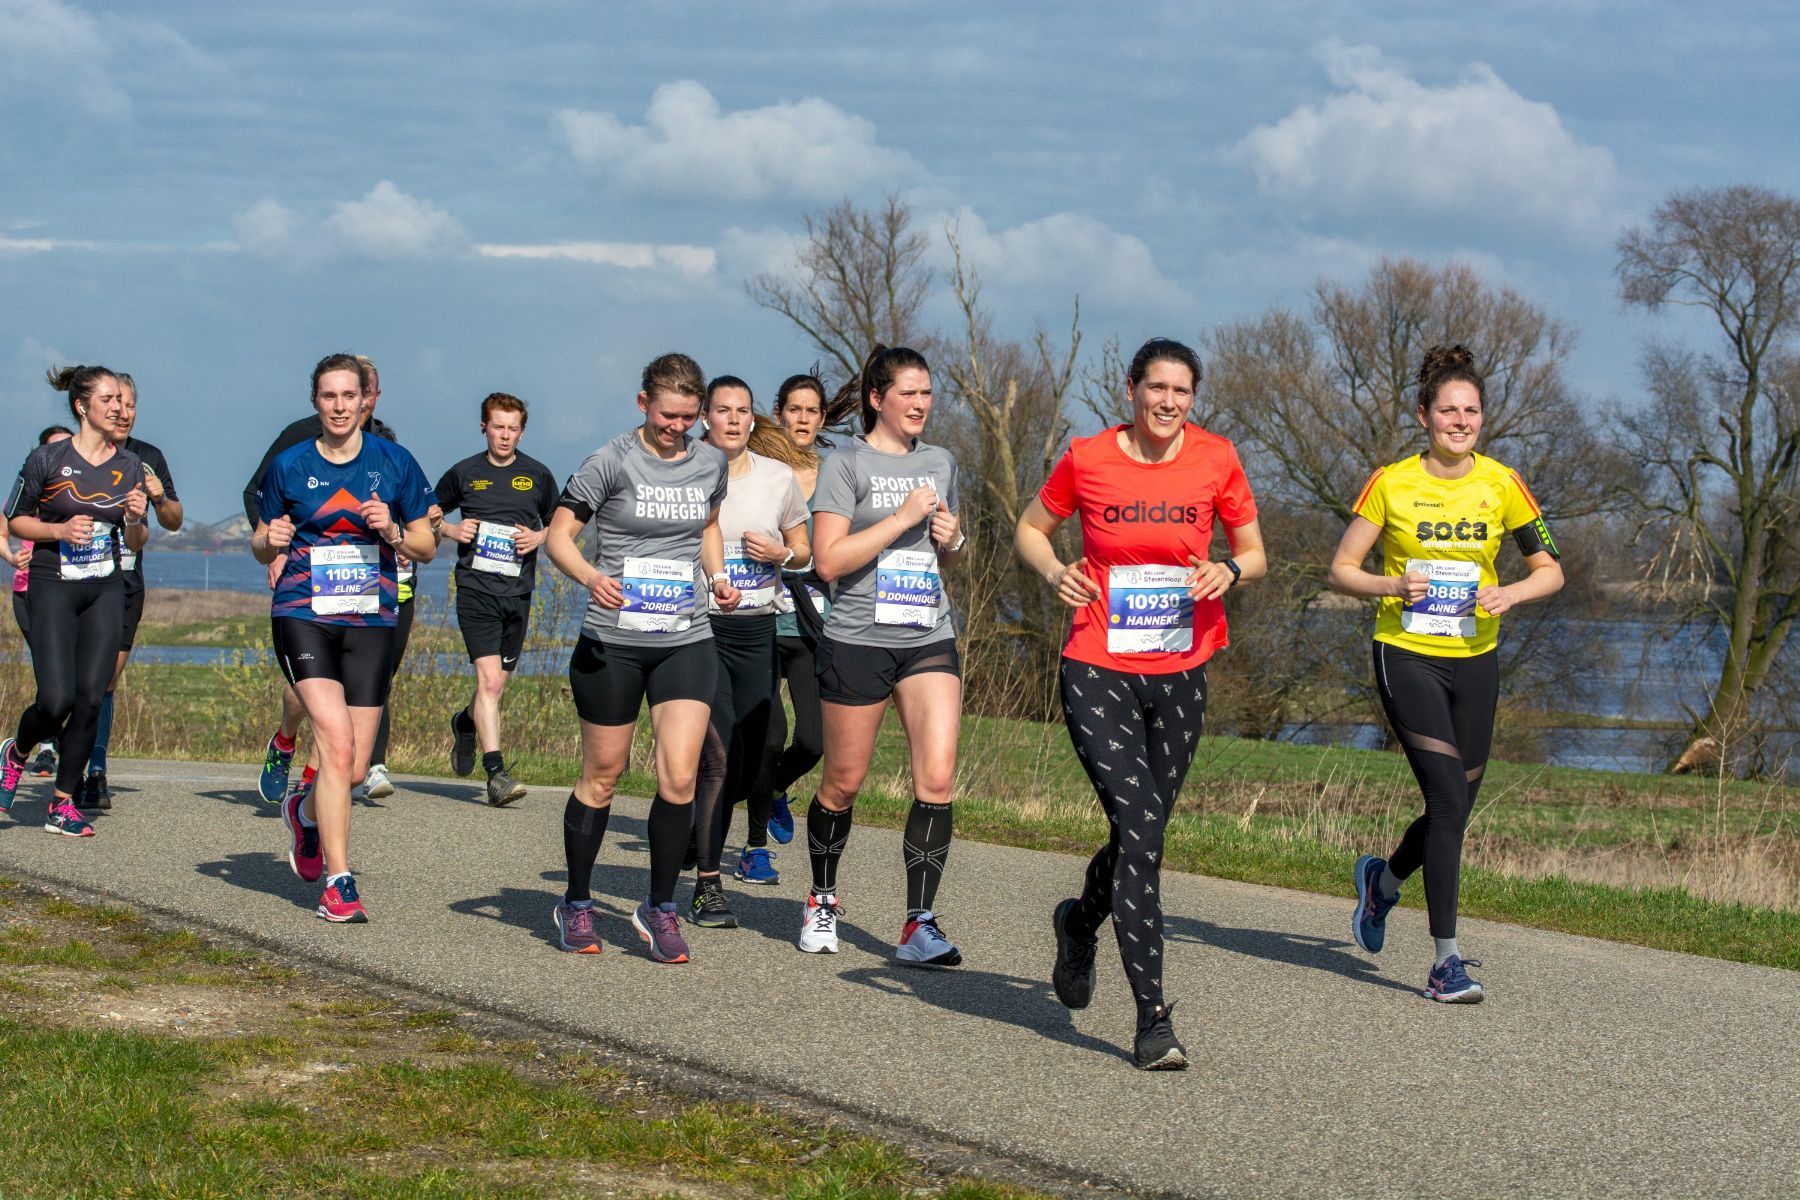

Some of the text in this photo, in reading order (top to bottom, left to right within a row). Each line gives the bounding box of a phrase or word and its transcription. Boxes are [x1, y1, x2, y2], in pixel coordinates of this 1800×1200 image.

[870, 476, 915, 492] SPORT
[637, 484, 706, 503] SPORT EN
[635, 501, 706, 520] BEWEGEN
[1103, 501, 1198, 524] adidas
[486, 539, 516, 553] 1145
[71, 553, 105, 563] MARLOES
[486, 550, 514, 562] THOMAS
[326, 568, 367, 581] 11013
[724, 563, 764, 576] 11416
[334, 584, 362, 593] ELINE
[732, 579, 757, 588] VERA
[892, 575, 933, 590] 11768
[638, 583, 682, 599] 11769
[1425, 585, 1469, 601] 0885
[886, 592, 937, 604] DOMINIQUE
[1125, 593, 1180, 610] 10930
[640, 601, 678, 612] JORIEN
[1427, 603, 1459, 614] ANNE
[1126, 614, 1180, 626] HANNEKE
